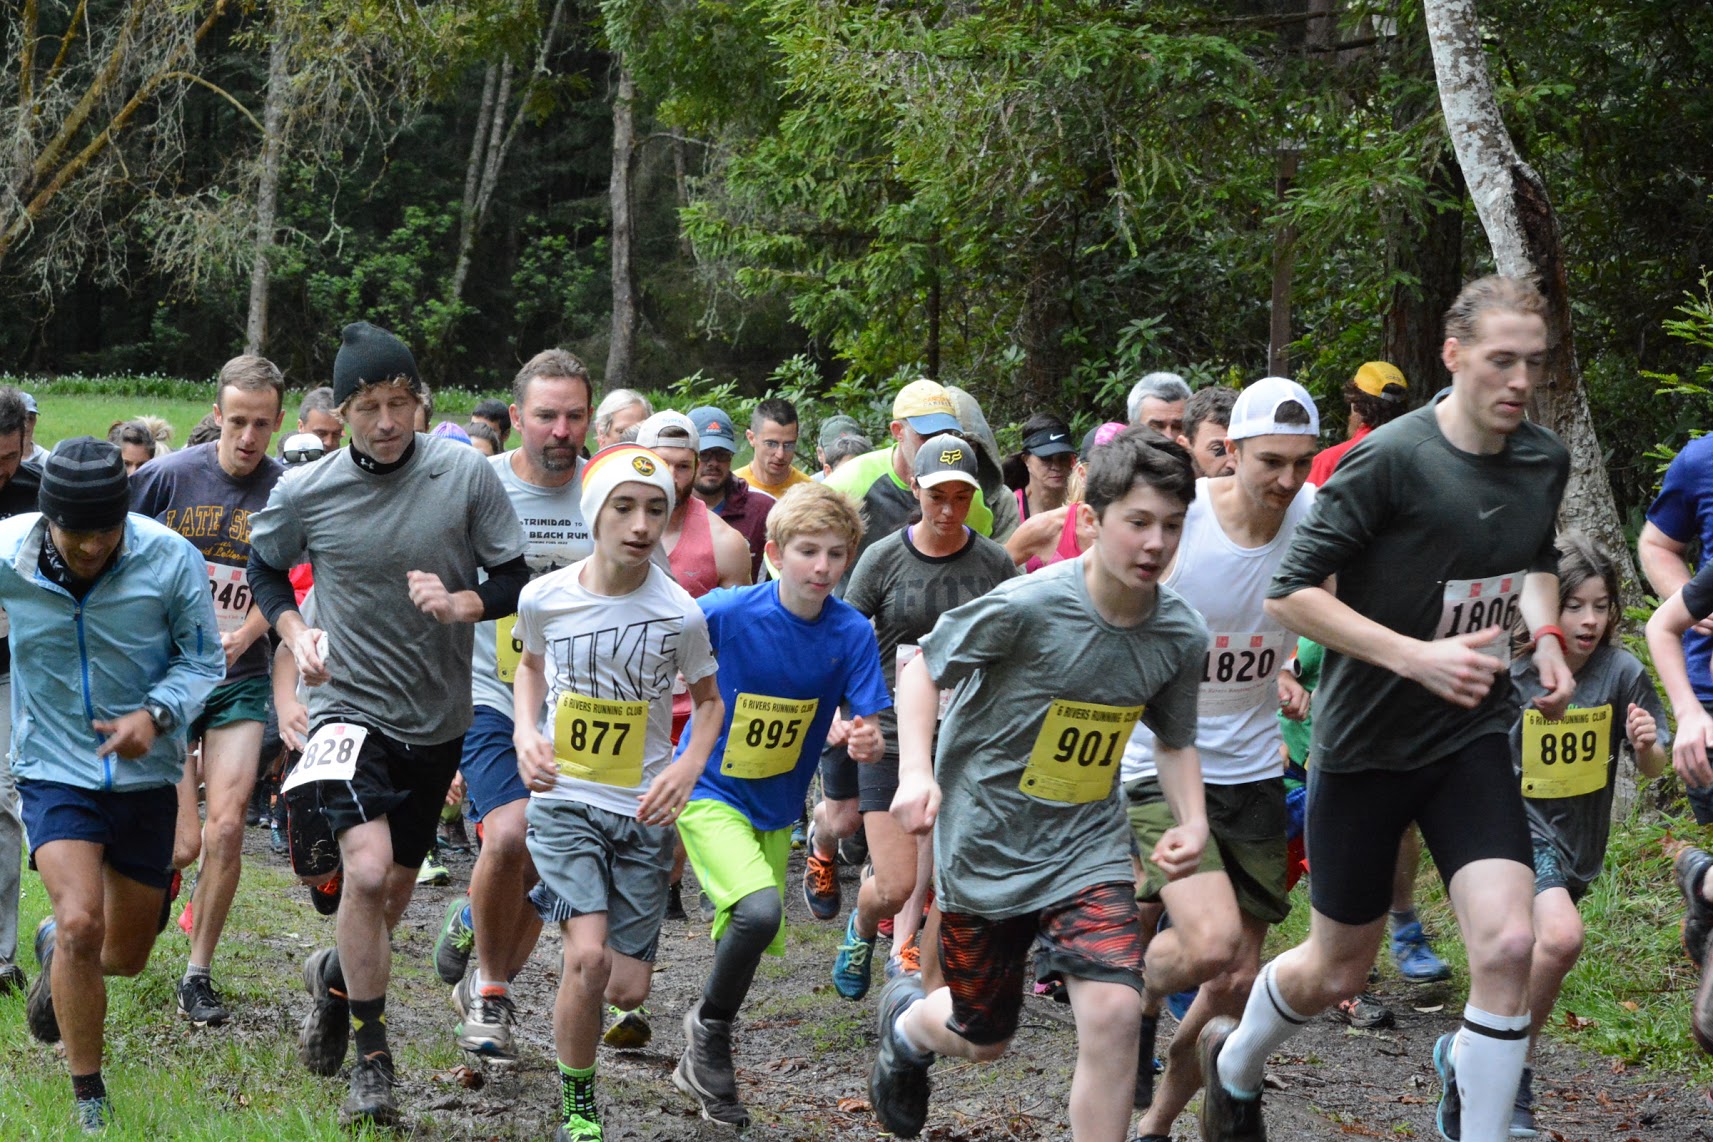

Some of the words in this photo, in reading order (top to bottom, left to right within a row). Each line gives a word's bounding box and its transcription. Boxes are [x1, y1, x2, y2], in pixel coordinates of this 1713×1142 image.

[166, 505, 224, 537] LATE
[523, 518, 571, 526] TRINIDAD
[529, 531, 564, 539] BEACH
[567, 532, 589, 540] RUN
[1445, 594, 1519, 638] 1806
[1200, 648, 1275, 683] 1820
[563, 696, 569, 707] 6
[569, 698, 591, 712] RIVERS
[592, 703, 623, 716] RUNNING
[626, 706, 643, 716] CLUB
[742, 698, 748, 708] 6
[748, 700, 771, 712] RIVERS
[771, 703, 799, 714] RUNNING
[800, 703, 815, 714] CLUB
[1056, 705, 1064, 716] 6
[1063, 706, 1092, 720] RIVERS
[1091, 710, 1124, 723] RUNNING
[1529, 715, 1535, 725] 6
[1560, 713, 1590, 725] RUNNING
[1592, 710, 1607, 722] CLUB
[570, 718, 631, 756] 877
[745, 718, 802, 749] 895
[1053, 727, 1121, 767] 901
[1541, 730, 1597, 765] 889
